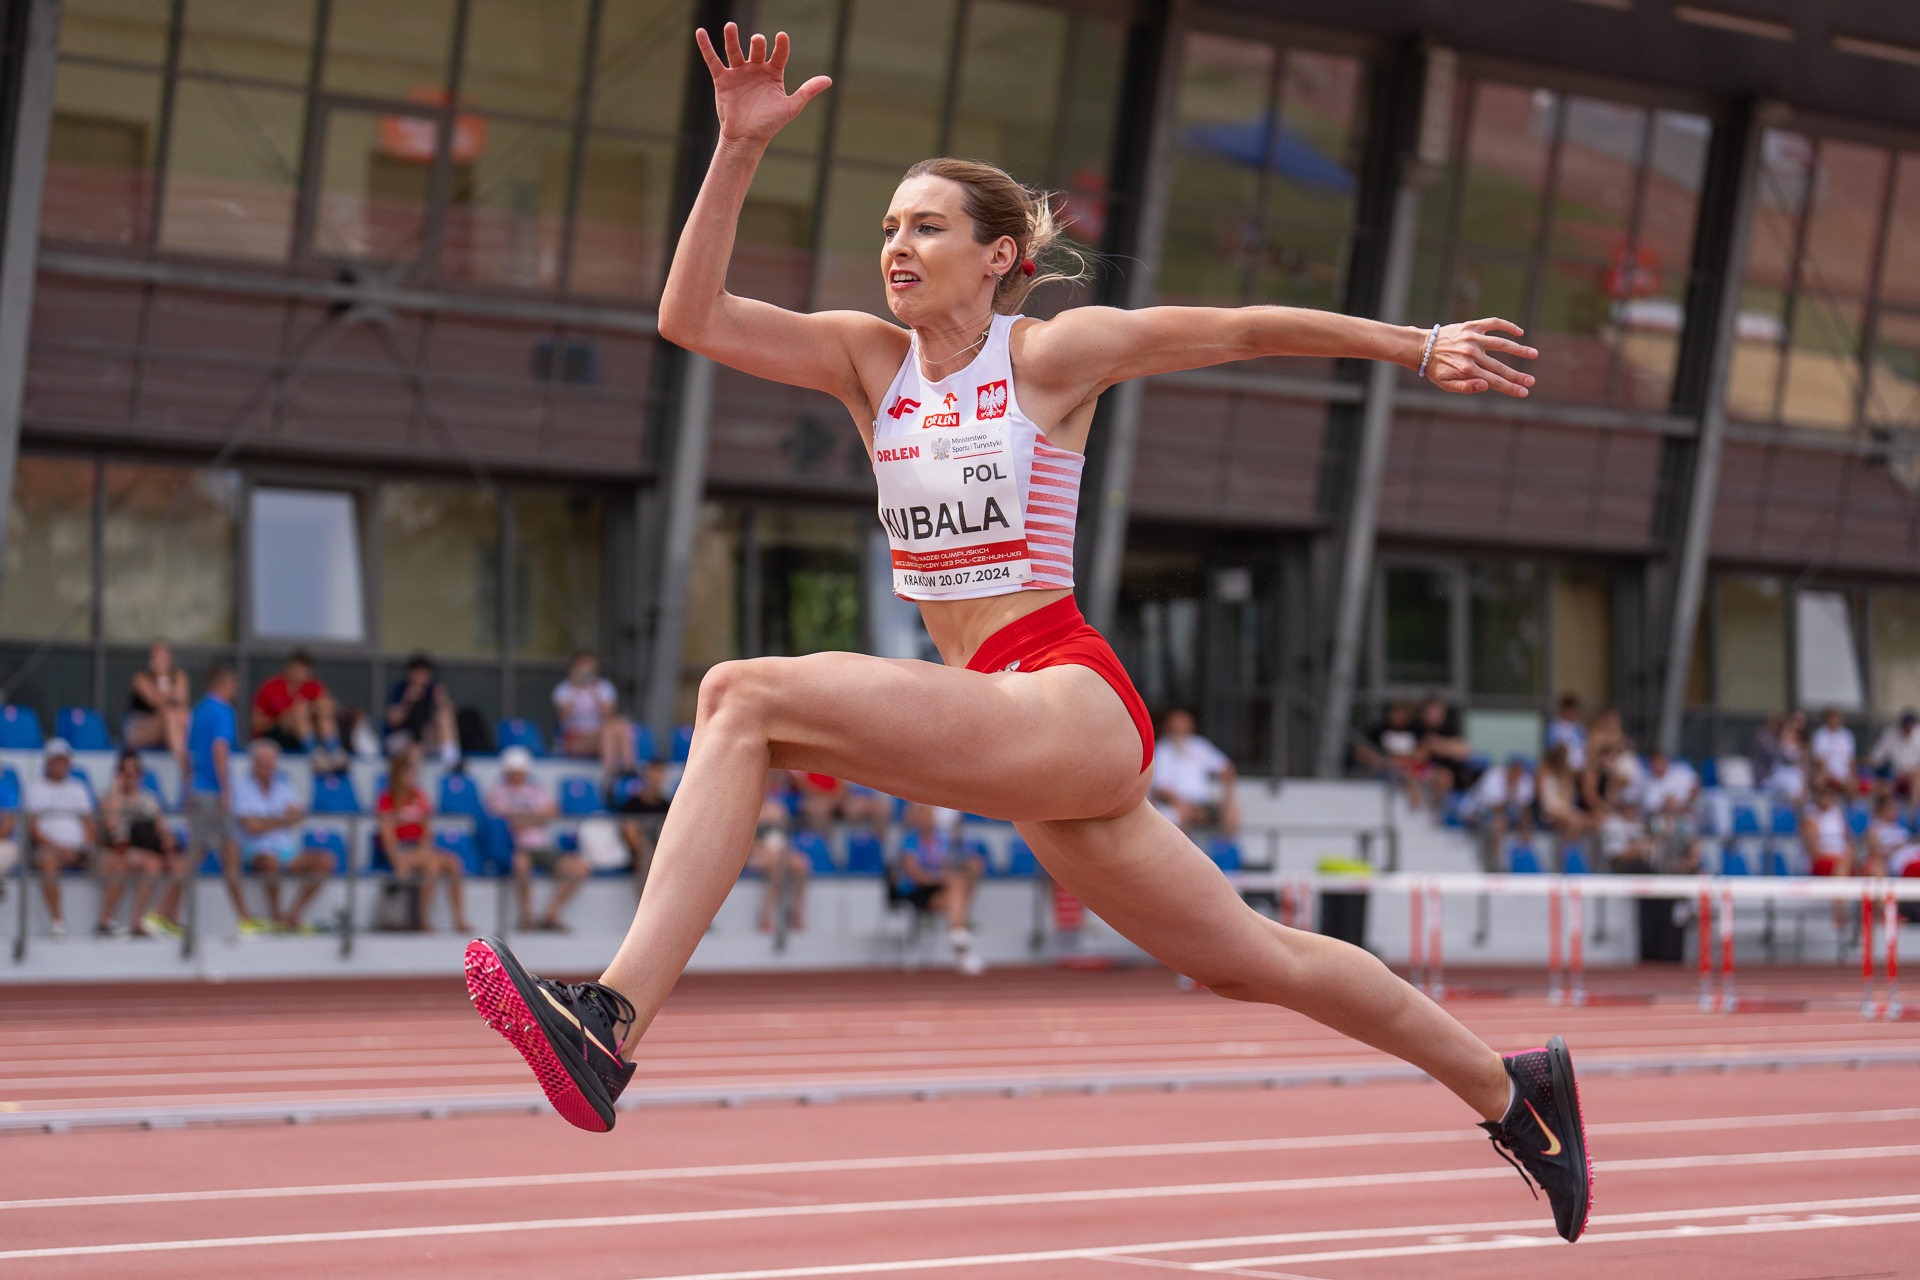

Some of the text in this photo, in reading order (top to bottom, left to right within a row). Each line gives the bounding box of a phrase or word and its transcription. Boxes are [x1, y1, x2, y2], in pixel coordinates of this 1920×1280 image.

[924, 413, 958, 428] ORLEN
[951, 434, 987, 445] Ministerstwo
[952, 445, 970, 454] Sportu
[973, 439, 1003, 450] Turystyki
[877, 446, 920, 462] ORLEN
[963, 463, 1007, 484] POL
[881, 496, 1010, 540] KUBALA
[940, 547, 989, 559] OLIMPIJSKICH
[954, 550, 1022, 565] POL-CZE-HUN-UKR
[904, 566, 1010, 587] KRAKÓW 20.07.2024
